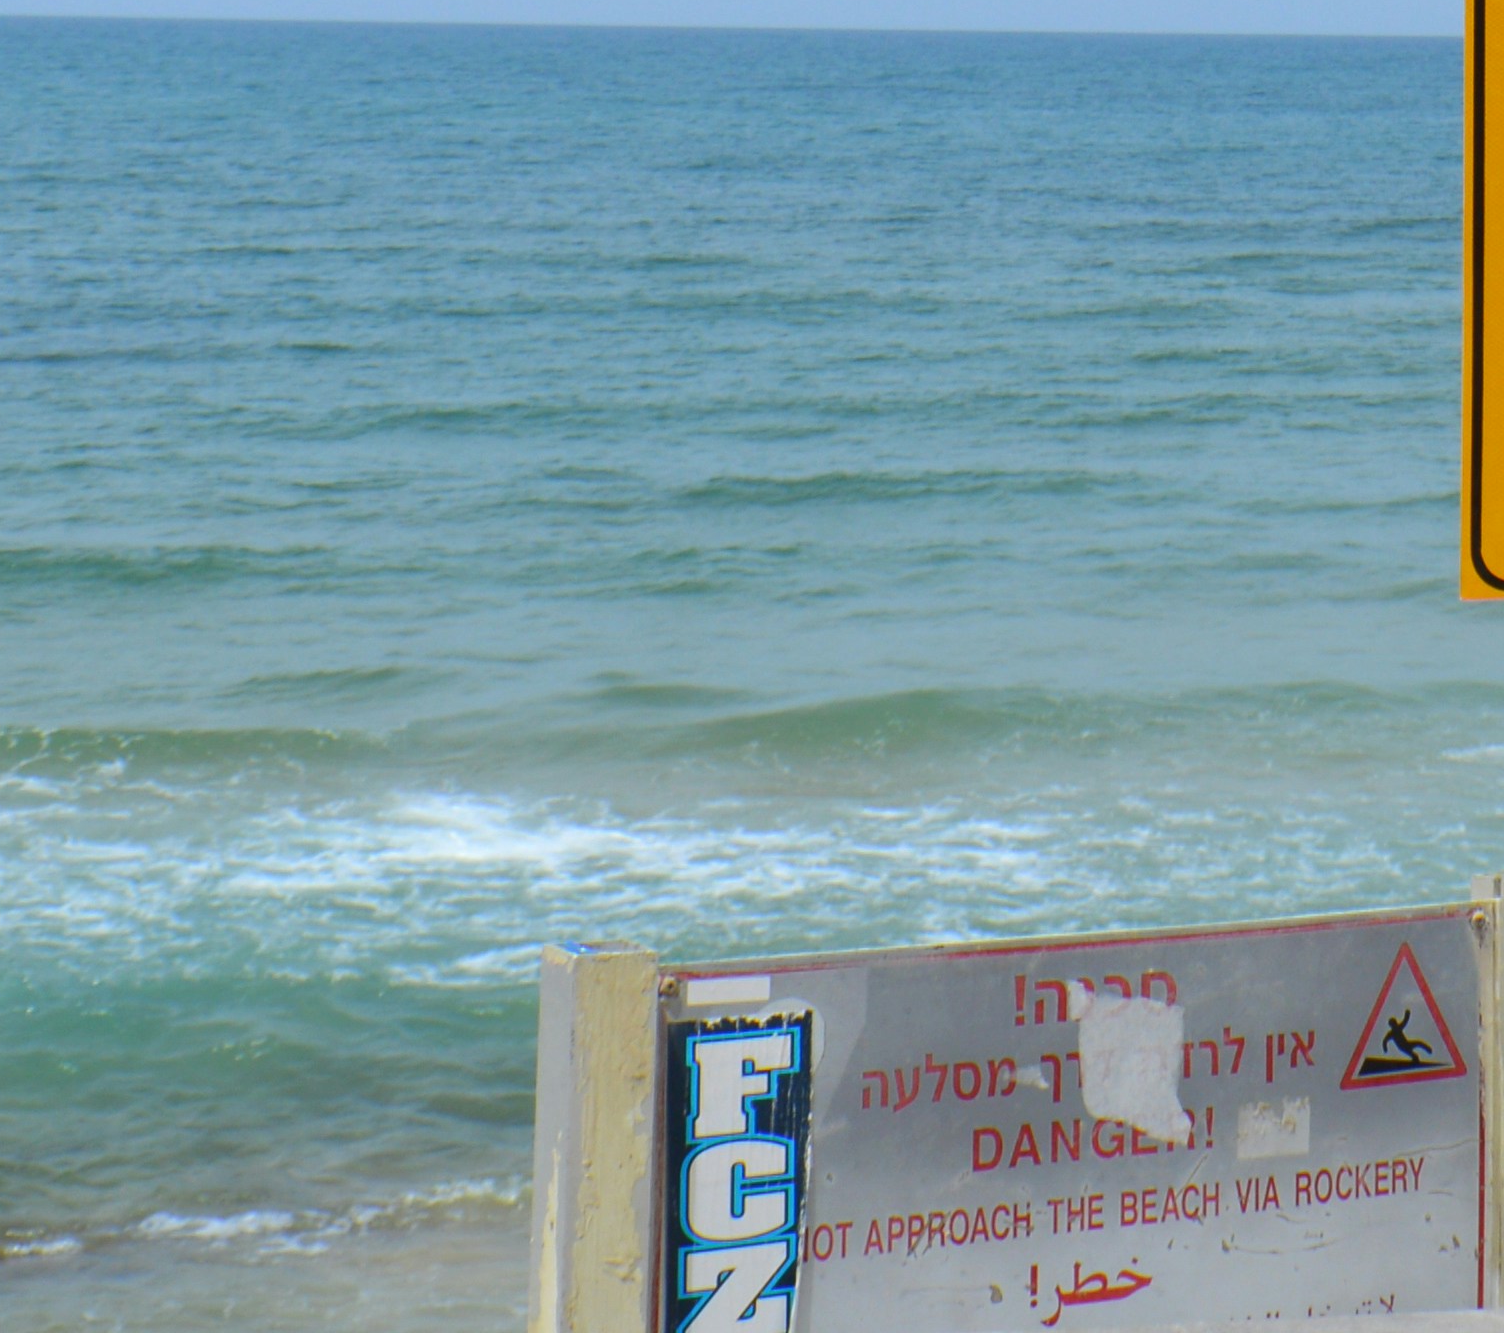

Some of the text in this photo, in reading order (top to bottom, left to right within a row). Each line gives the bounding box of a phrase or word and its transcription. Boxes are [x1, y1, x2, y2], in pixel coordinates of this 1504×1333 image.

[863, 1054, 1018, 1111] מסלעה
[1266, 1030, 1316, 1082] אין
[863, 1203, 1032, 1254] APPROACH
[1047, 1193, 1104, 1234] THE
[1120, 1182, 1221, 1226] BEACH
[1236, 1175, 1281, 1213] VIA
[1295, 1157, 1425, 1205] ROCKERY
[1029, 1259, 1153, 1328] خطر!
